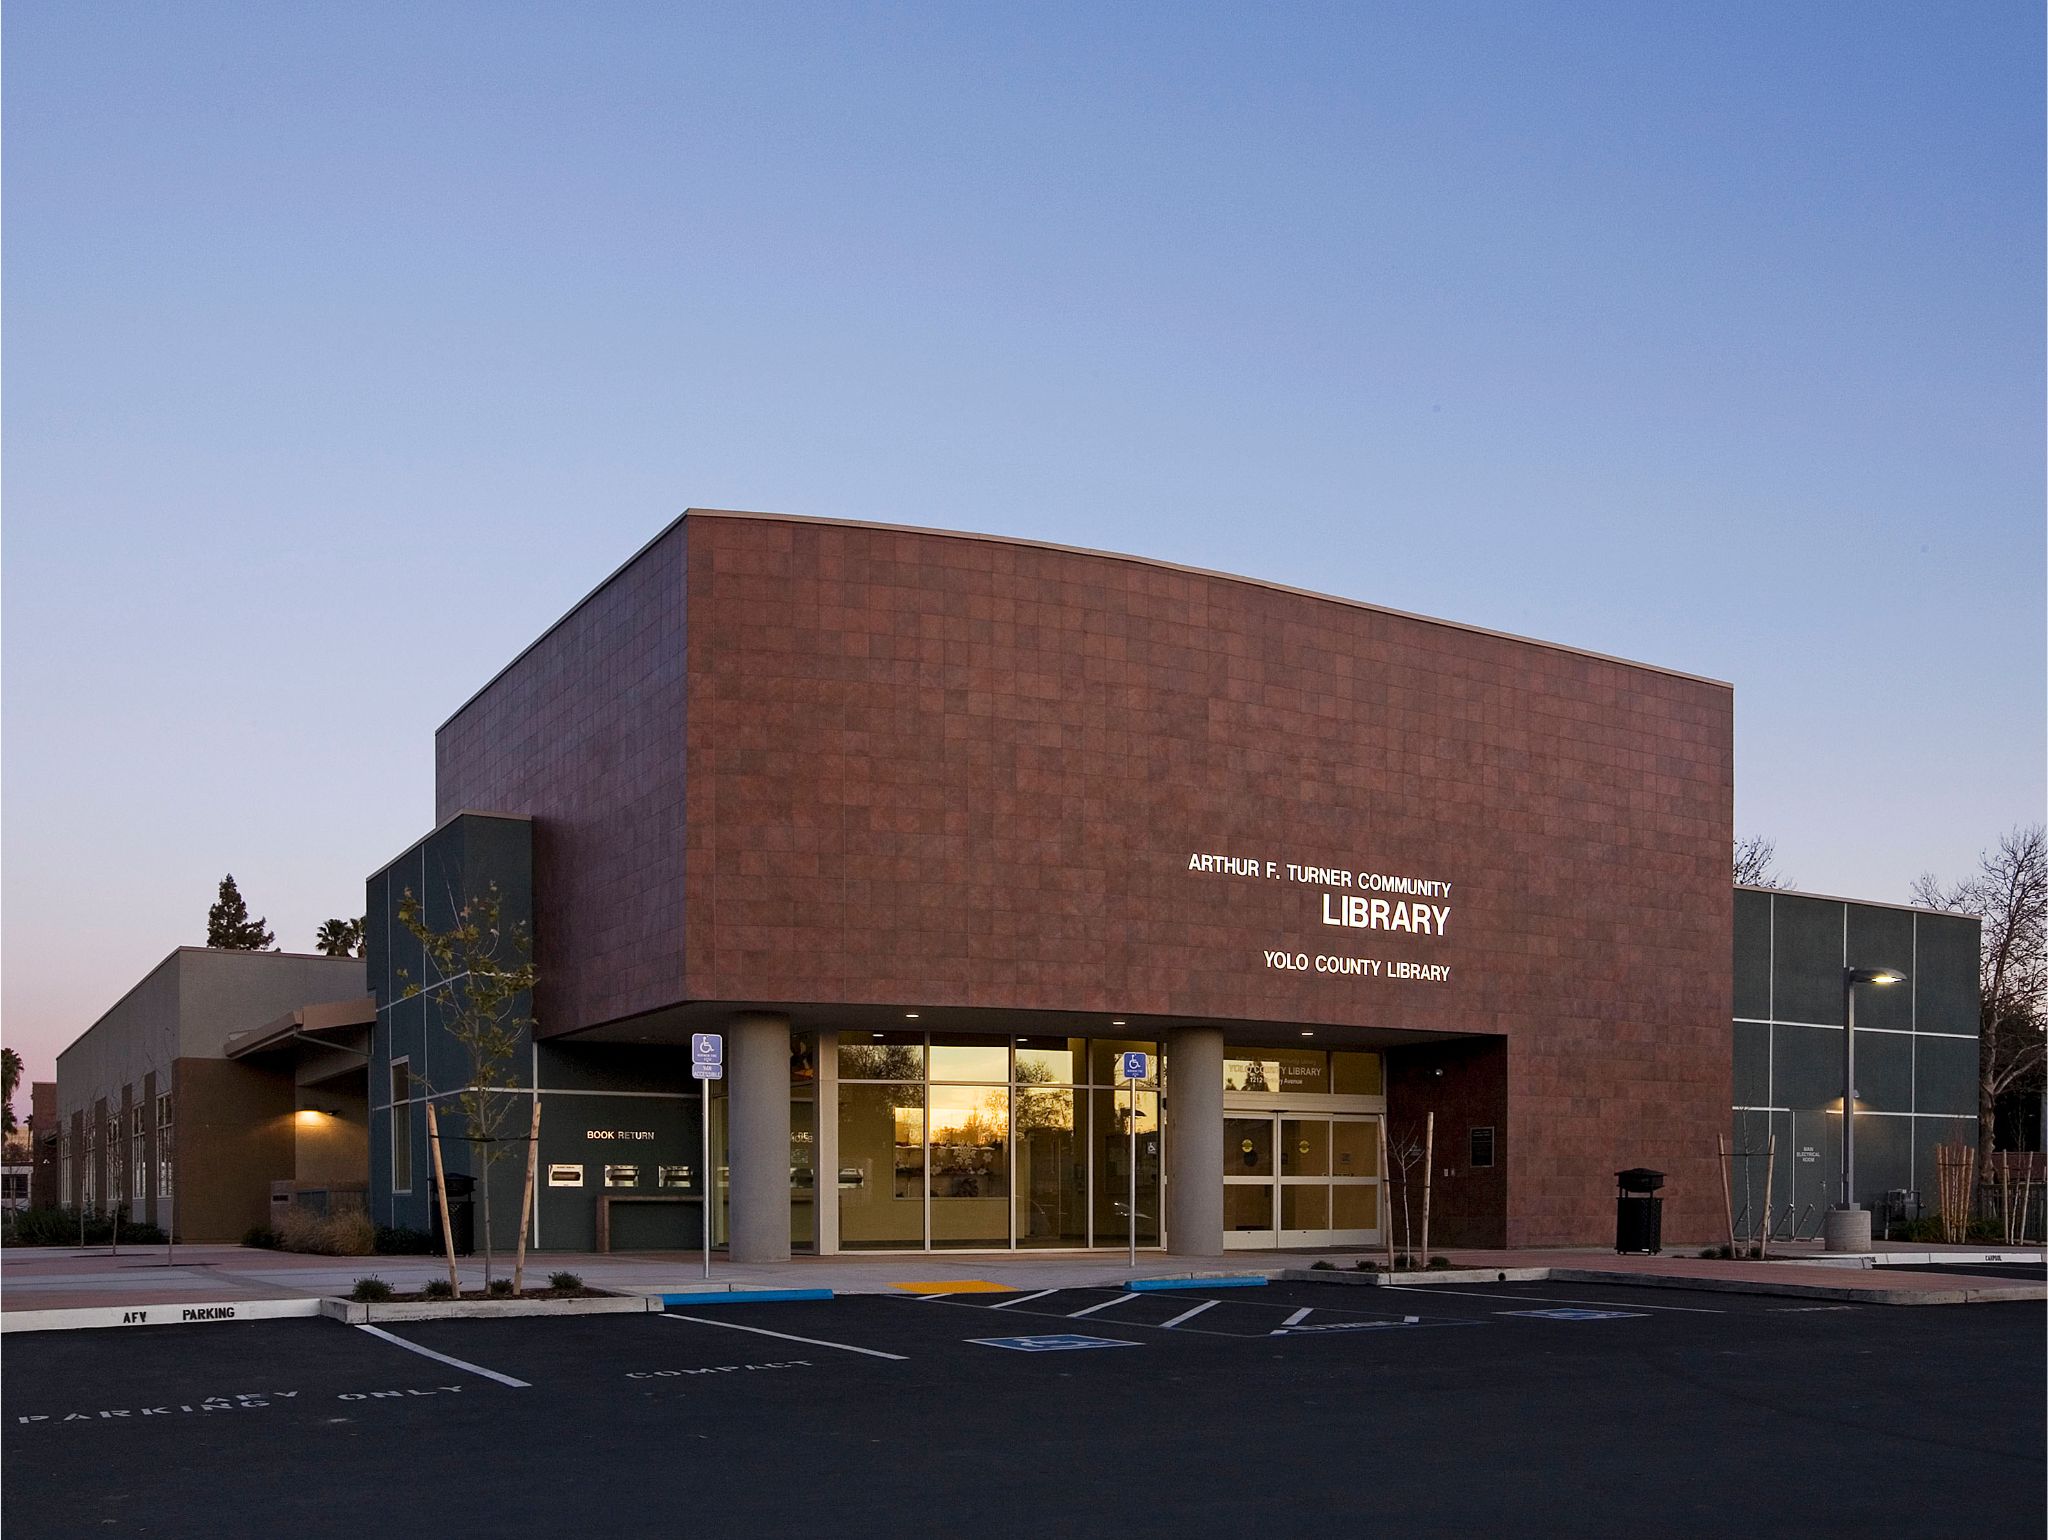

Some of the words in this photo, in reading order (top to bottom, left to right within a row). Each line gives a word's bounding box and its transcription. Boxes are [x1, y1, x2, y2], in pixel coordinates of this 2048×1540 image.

[1188, 853, 1259, 877] ARTHUR
[1266, 862, 1281, 879] F.
[1286, 864, 1352, 887] TURNER
[1357, 872, 1452, 898] COMMUNITY
[1322, 893, 1450, 936] LIBRARY
[1263, 950, 1309, 971] YOLO
[1315, 955, 1381, 976] COUNTY
[1387, 961, 1450, 982] LIBRARY
[1228, 1064, 1252, 1074] YOLO
[1288, 1066, 1322, 1076] LIBRARY
[587, 1130, 614, 1140] BOOK
[618, 1131, 655, 1140] RETURN
[123, 1311, 147, 1323] AFV
[182, 1307, 235, 1321] PARKING
[625, 1361, 812, 1378] COMPACT
[337, 1386, 463, 1400] ONLY
[18, 1400, 270, 1424] PARKING
